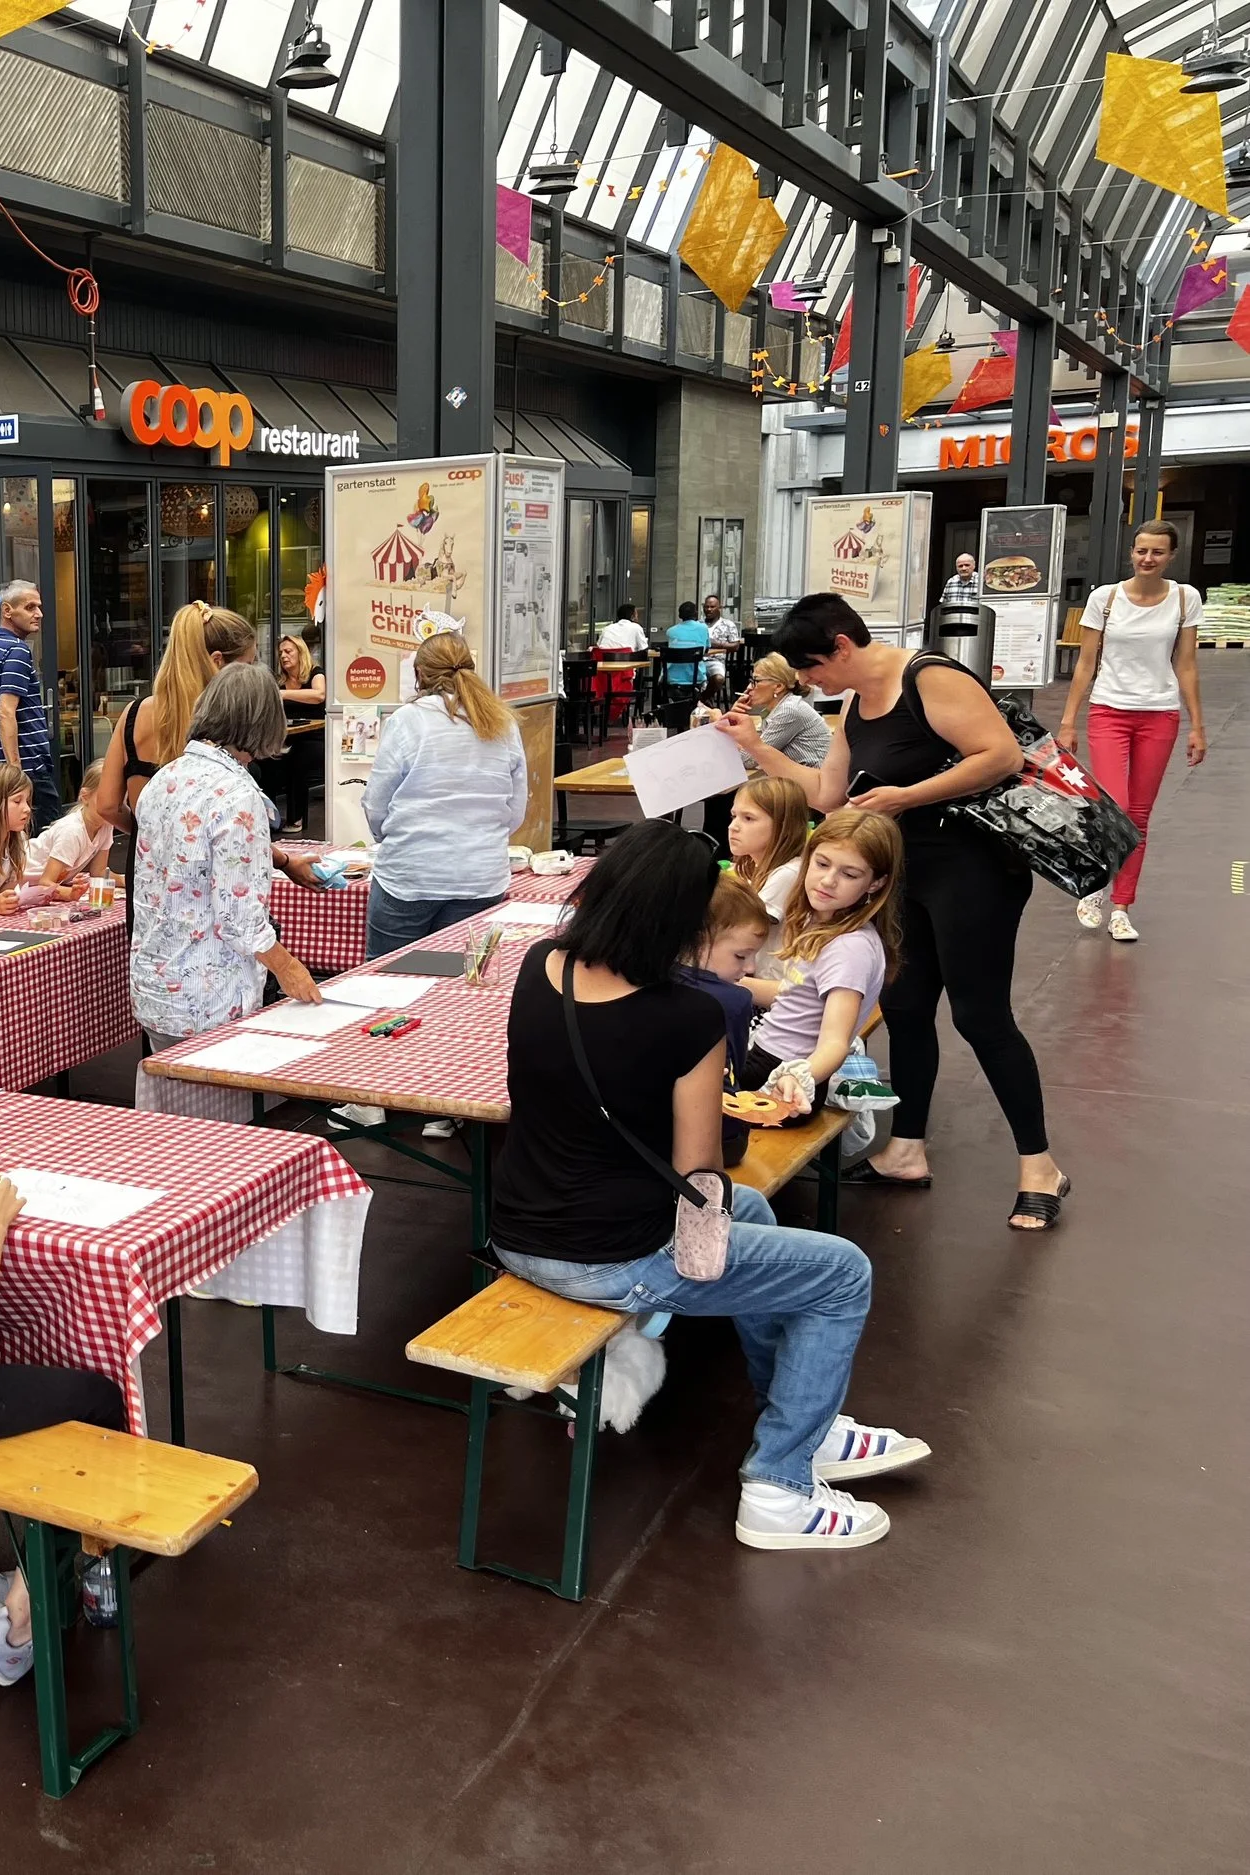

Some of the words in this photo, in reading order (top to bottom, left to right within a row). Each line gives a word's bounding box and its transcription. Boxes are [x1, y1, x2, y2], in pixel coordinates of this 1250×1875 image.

[855, 380, 870, 391] 42
[124, 379, 254, 467] coop
[260, 424, 360, 459] restaurant
[448, 469, 482, 481] coop
[337, 476, 396, 492] gartenstadt
[831, 568, 869, 580] Herbst
[831, 577, 868, 589] Chilbi
[371, 600, 424, 618] Herbs
[372, 615, 416, 636] Chil
